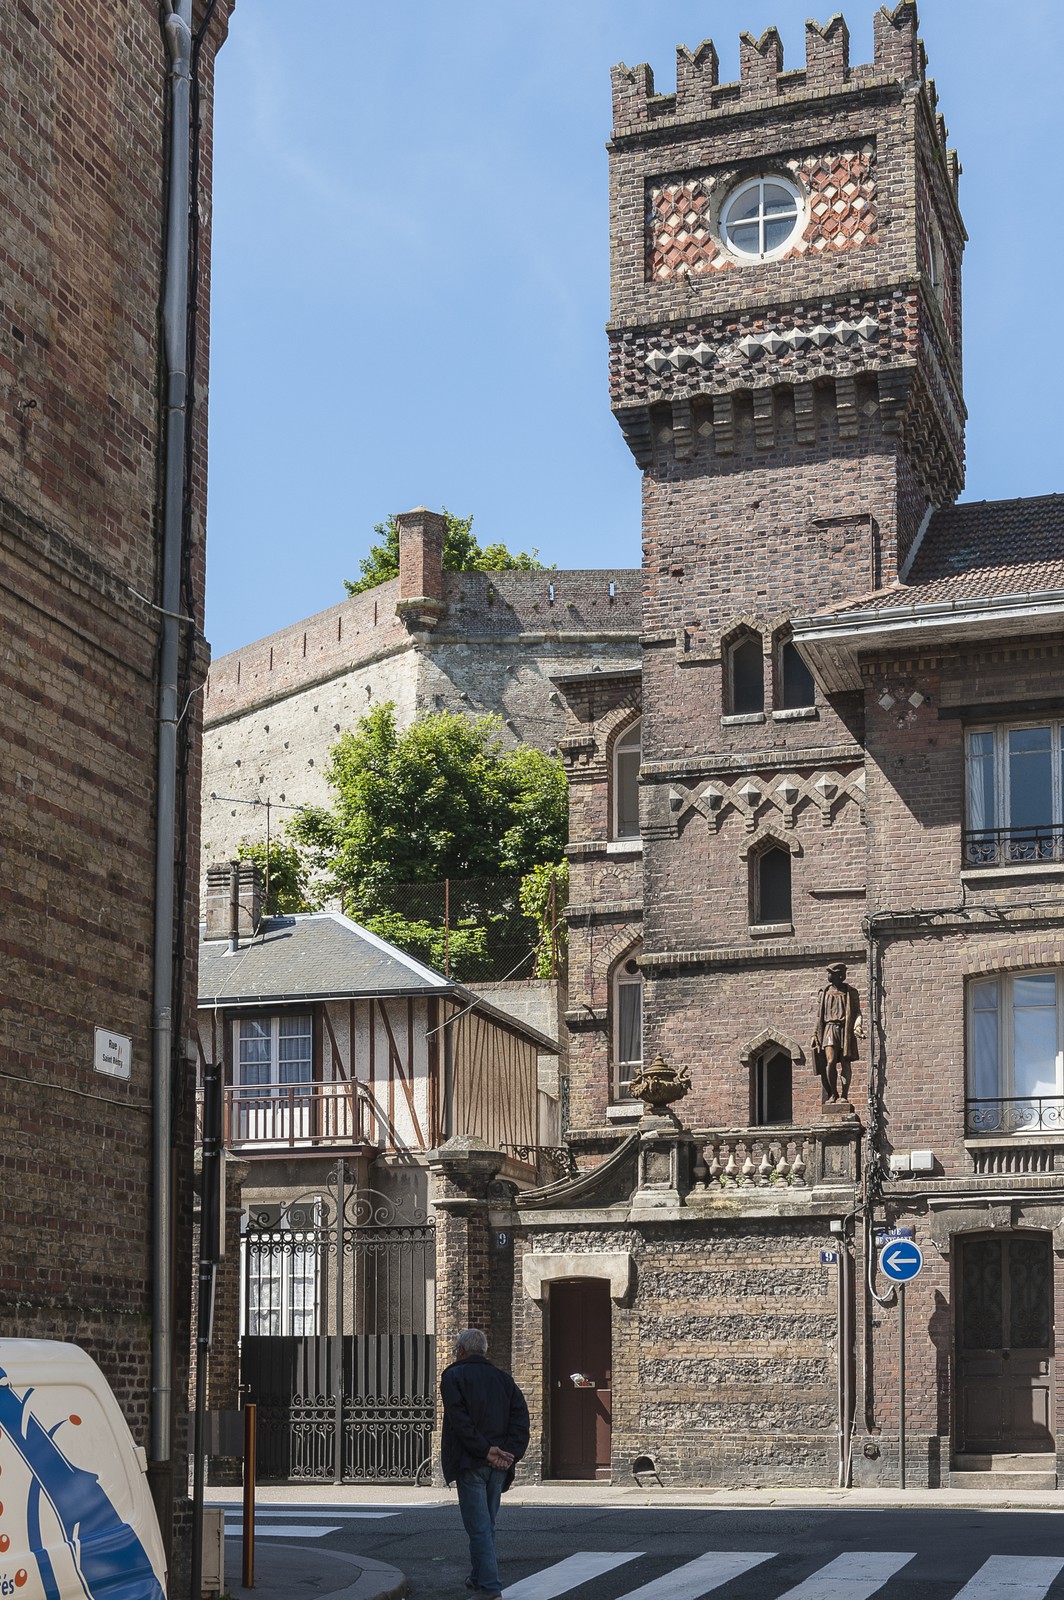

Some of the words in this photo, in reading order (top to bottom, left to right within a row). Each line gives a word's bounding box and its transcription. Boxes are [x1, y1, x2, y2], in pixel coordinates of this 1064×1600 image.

[108, 1039, 117, 1050] Rue
[102, 1053, 112, 1064] Saint
[499, 1233, 506, 1245] 9
[825, 1252, 833, 1262] 9
[0, 1574, 14, 1596] és
